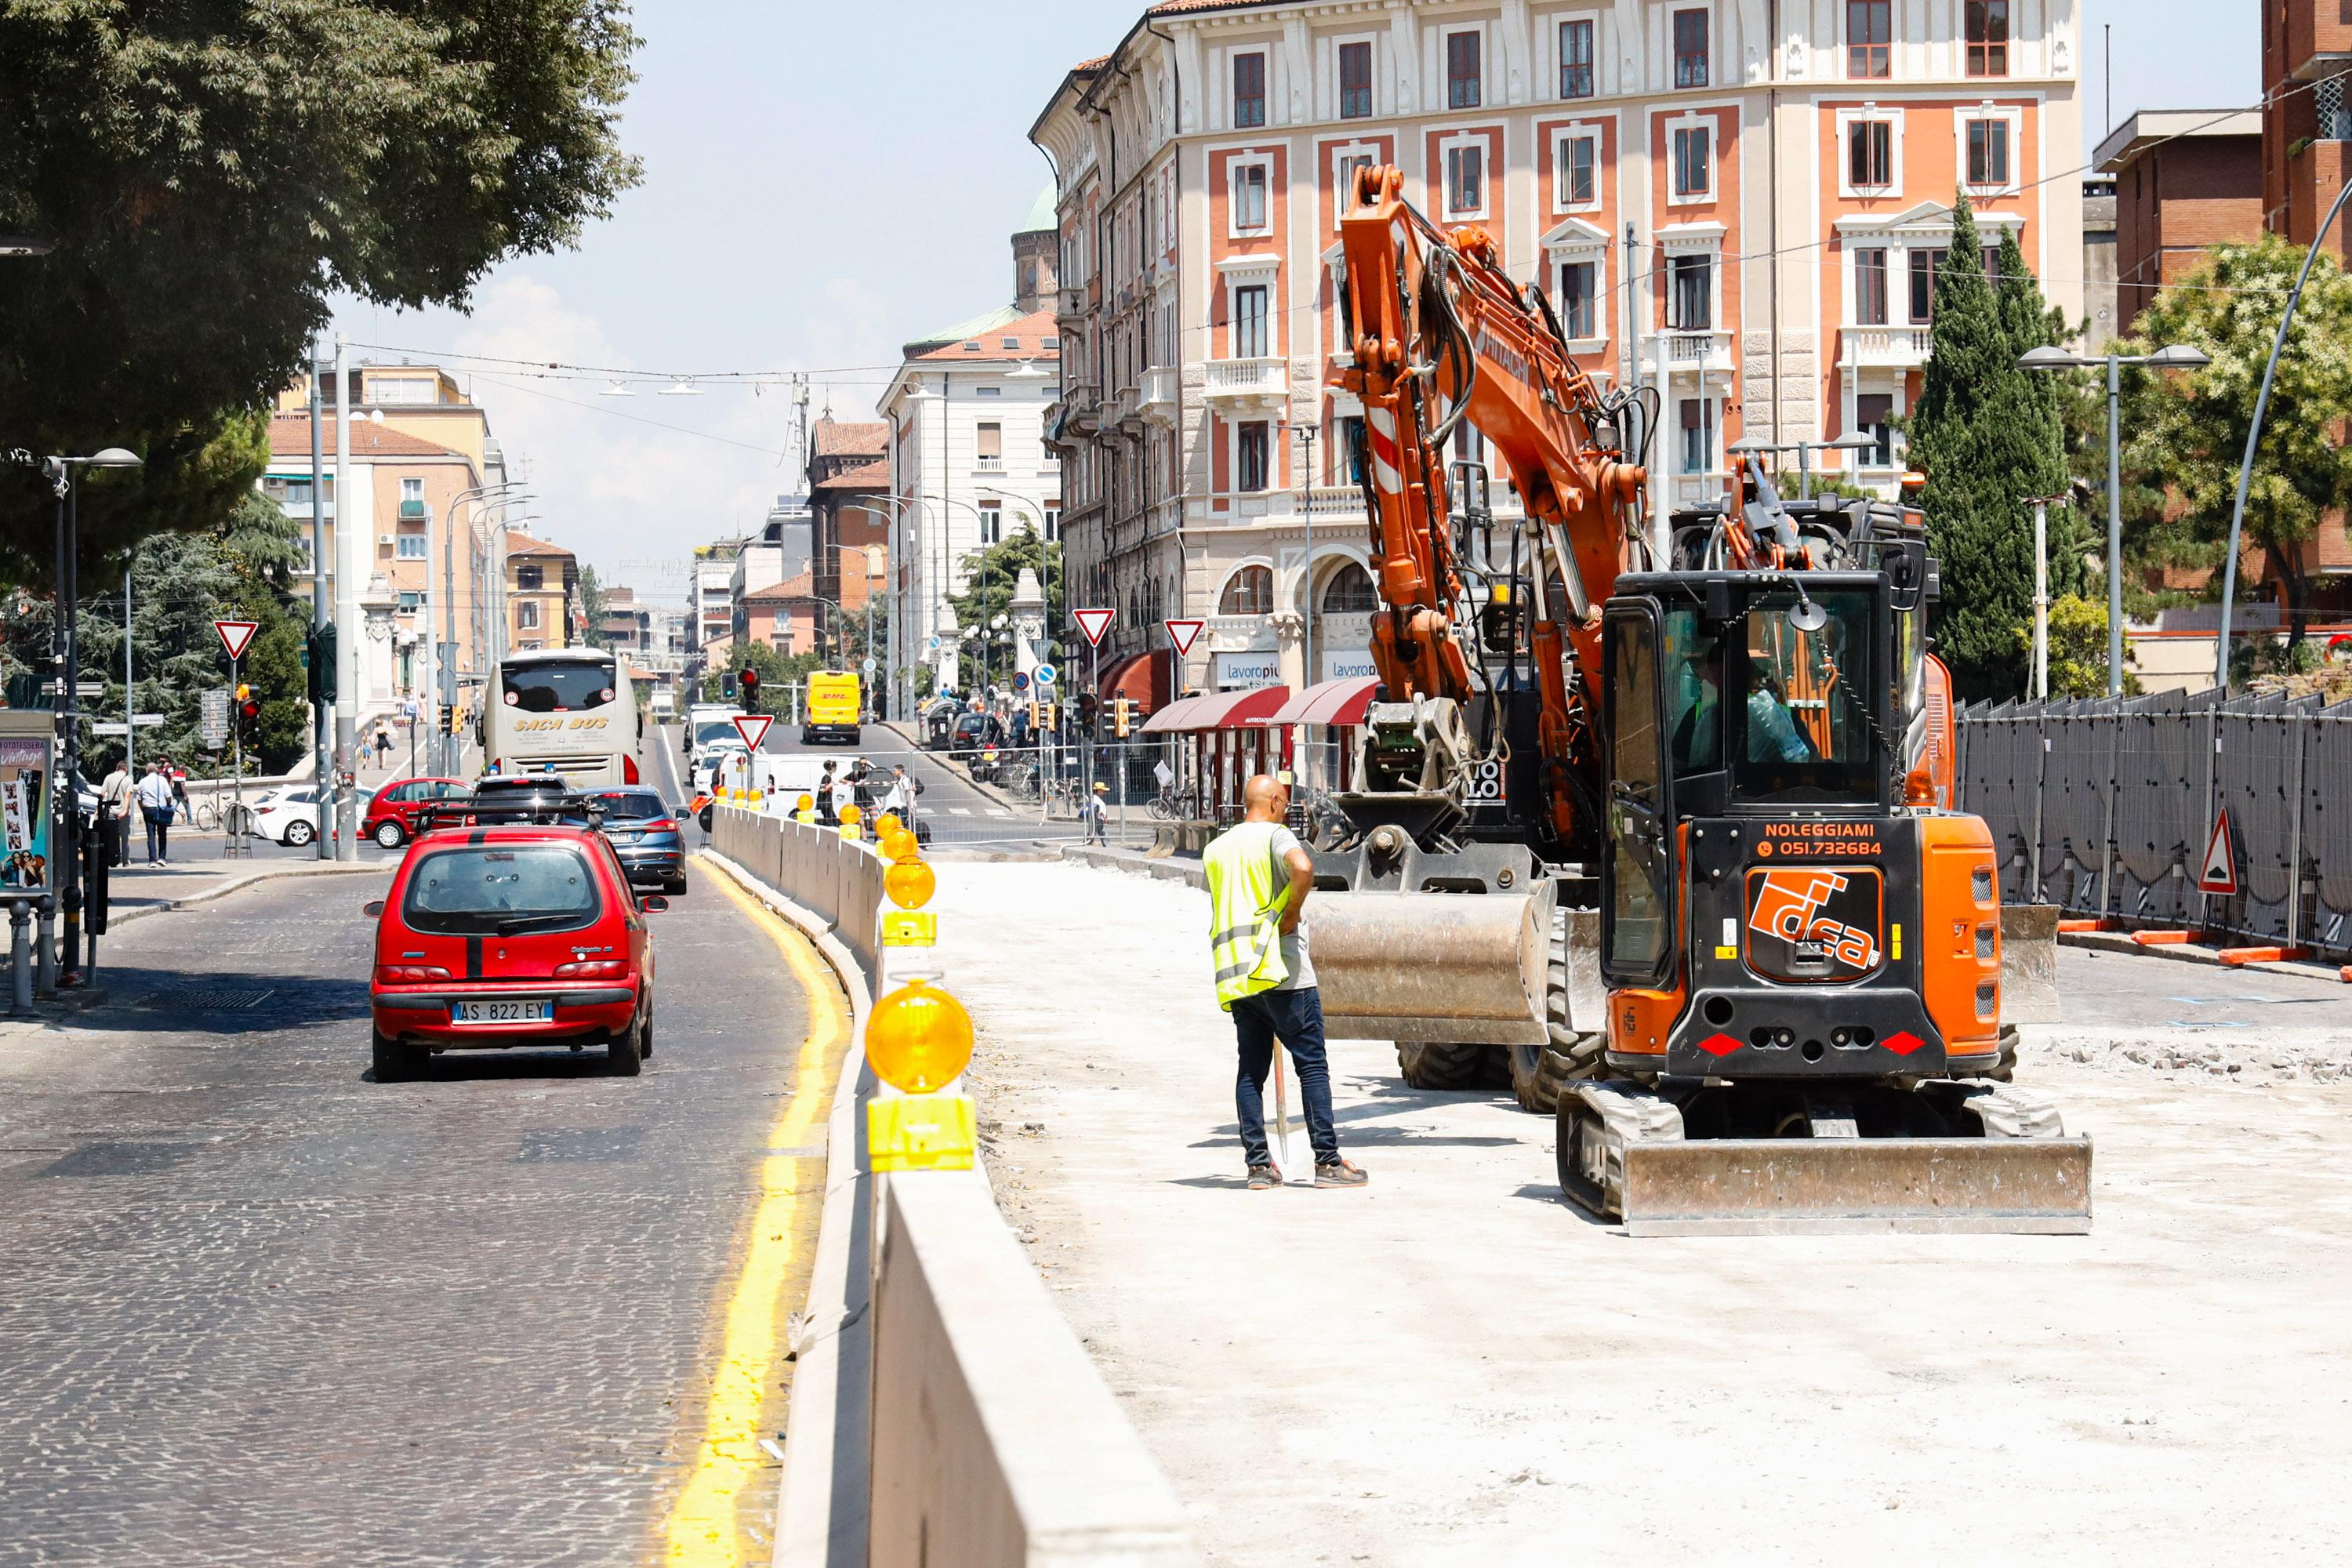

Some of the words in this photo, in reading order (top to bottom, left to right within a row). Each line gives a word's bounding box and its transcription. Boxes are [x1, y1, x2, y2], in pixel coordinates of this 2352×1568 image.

[1486, 328, 1529, 386] HITACHI
[1334, 662, 1380, 677] lavorop
[514, 718, 564, 732] SACA
[568, 717, 609, 729] BUS
[0, 741, 45, 750] FOTOTESSERA
[1765, 823, 1875, 837] NOLEGGIAMI
[1780, 841, 1882, 855] 051.732684
[461, 1004, 479, 1020] AS
[489, 1004, 519, 1020] 822
[525, 1001, 544, 1019] EY
